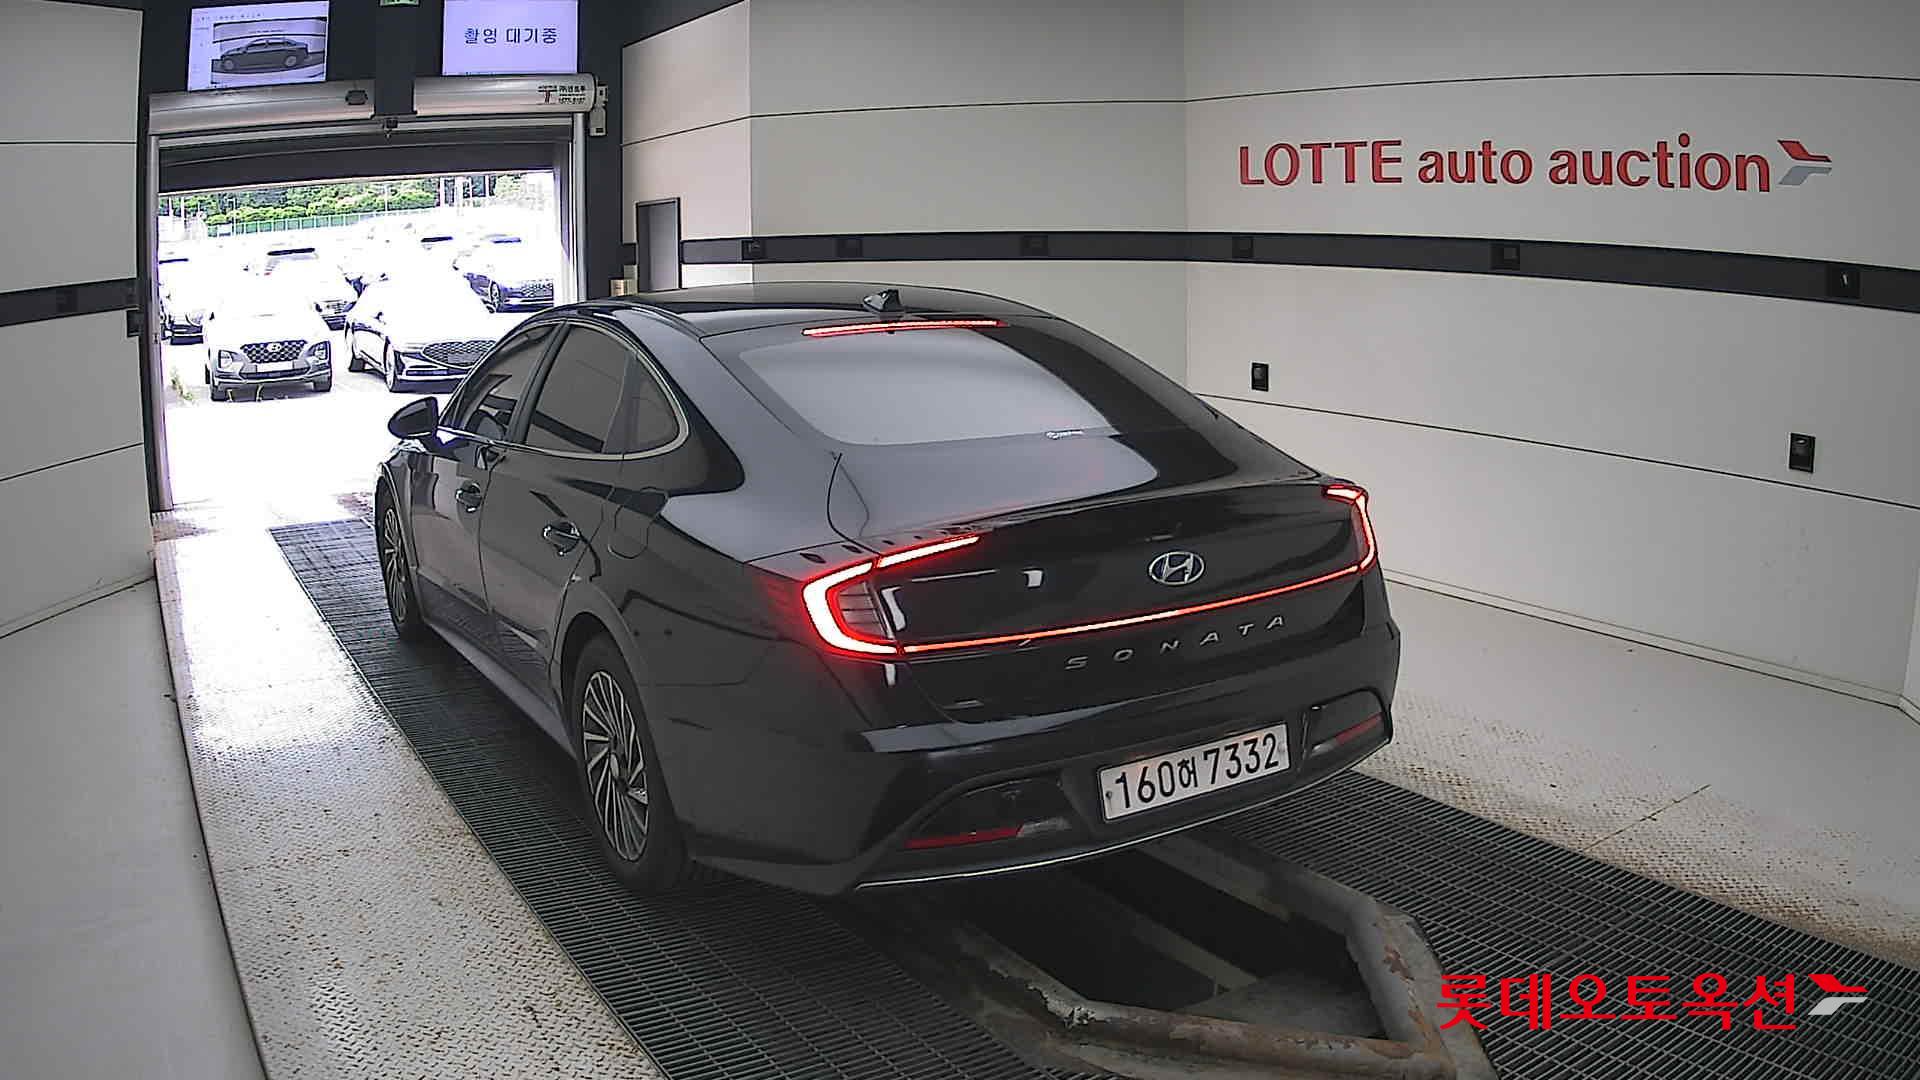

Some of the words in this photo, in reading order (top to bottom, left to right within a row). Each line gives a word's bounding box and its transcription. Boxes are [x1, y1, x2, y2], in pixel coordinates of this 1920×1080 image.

[505, 27, 558, 45] 대기중
[1240, 141, 1402, 185] LOTTE
[1418, 140, 1533, 184] auto
[1549, 133, 1771, 192] auction
[1065, 615, 1285, 670] SONATA
